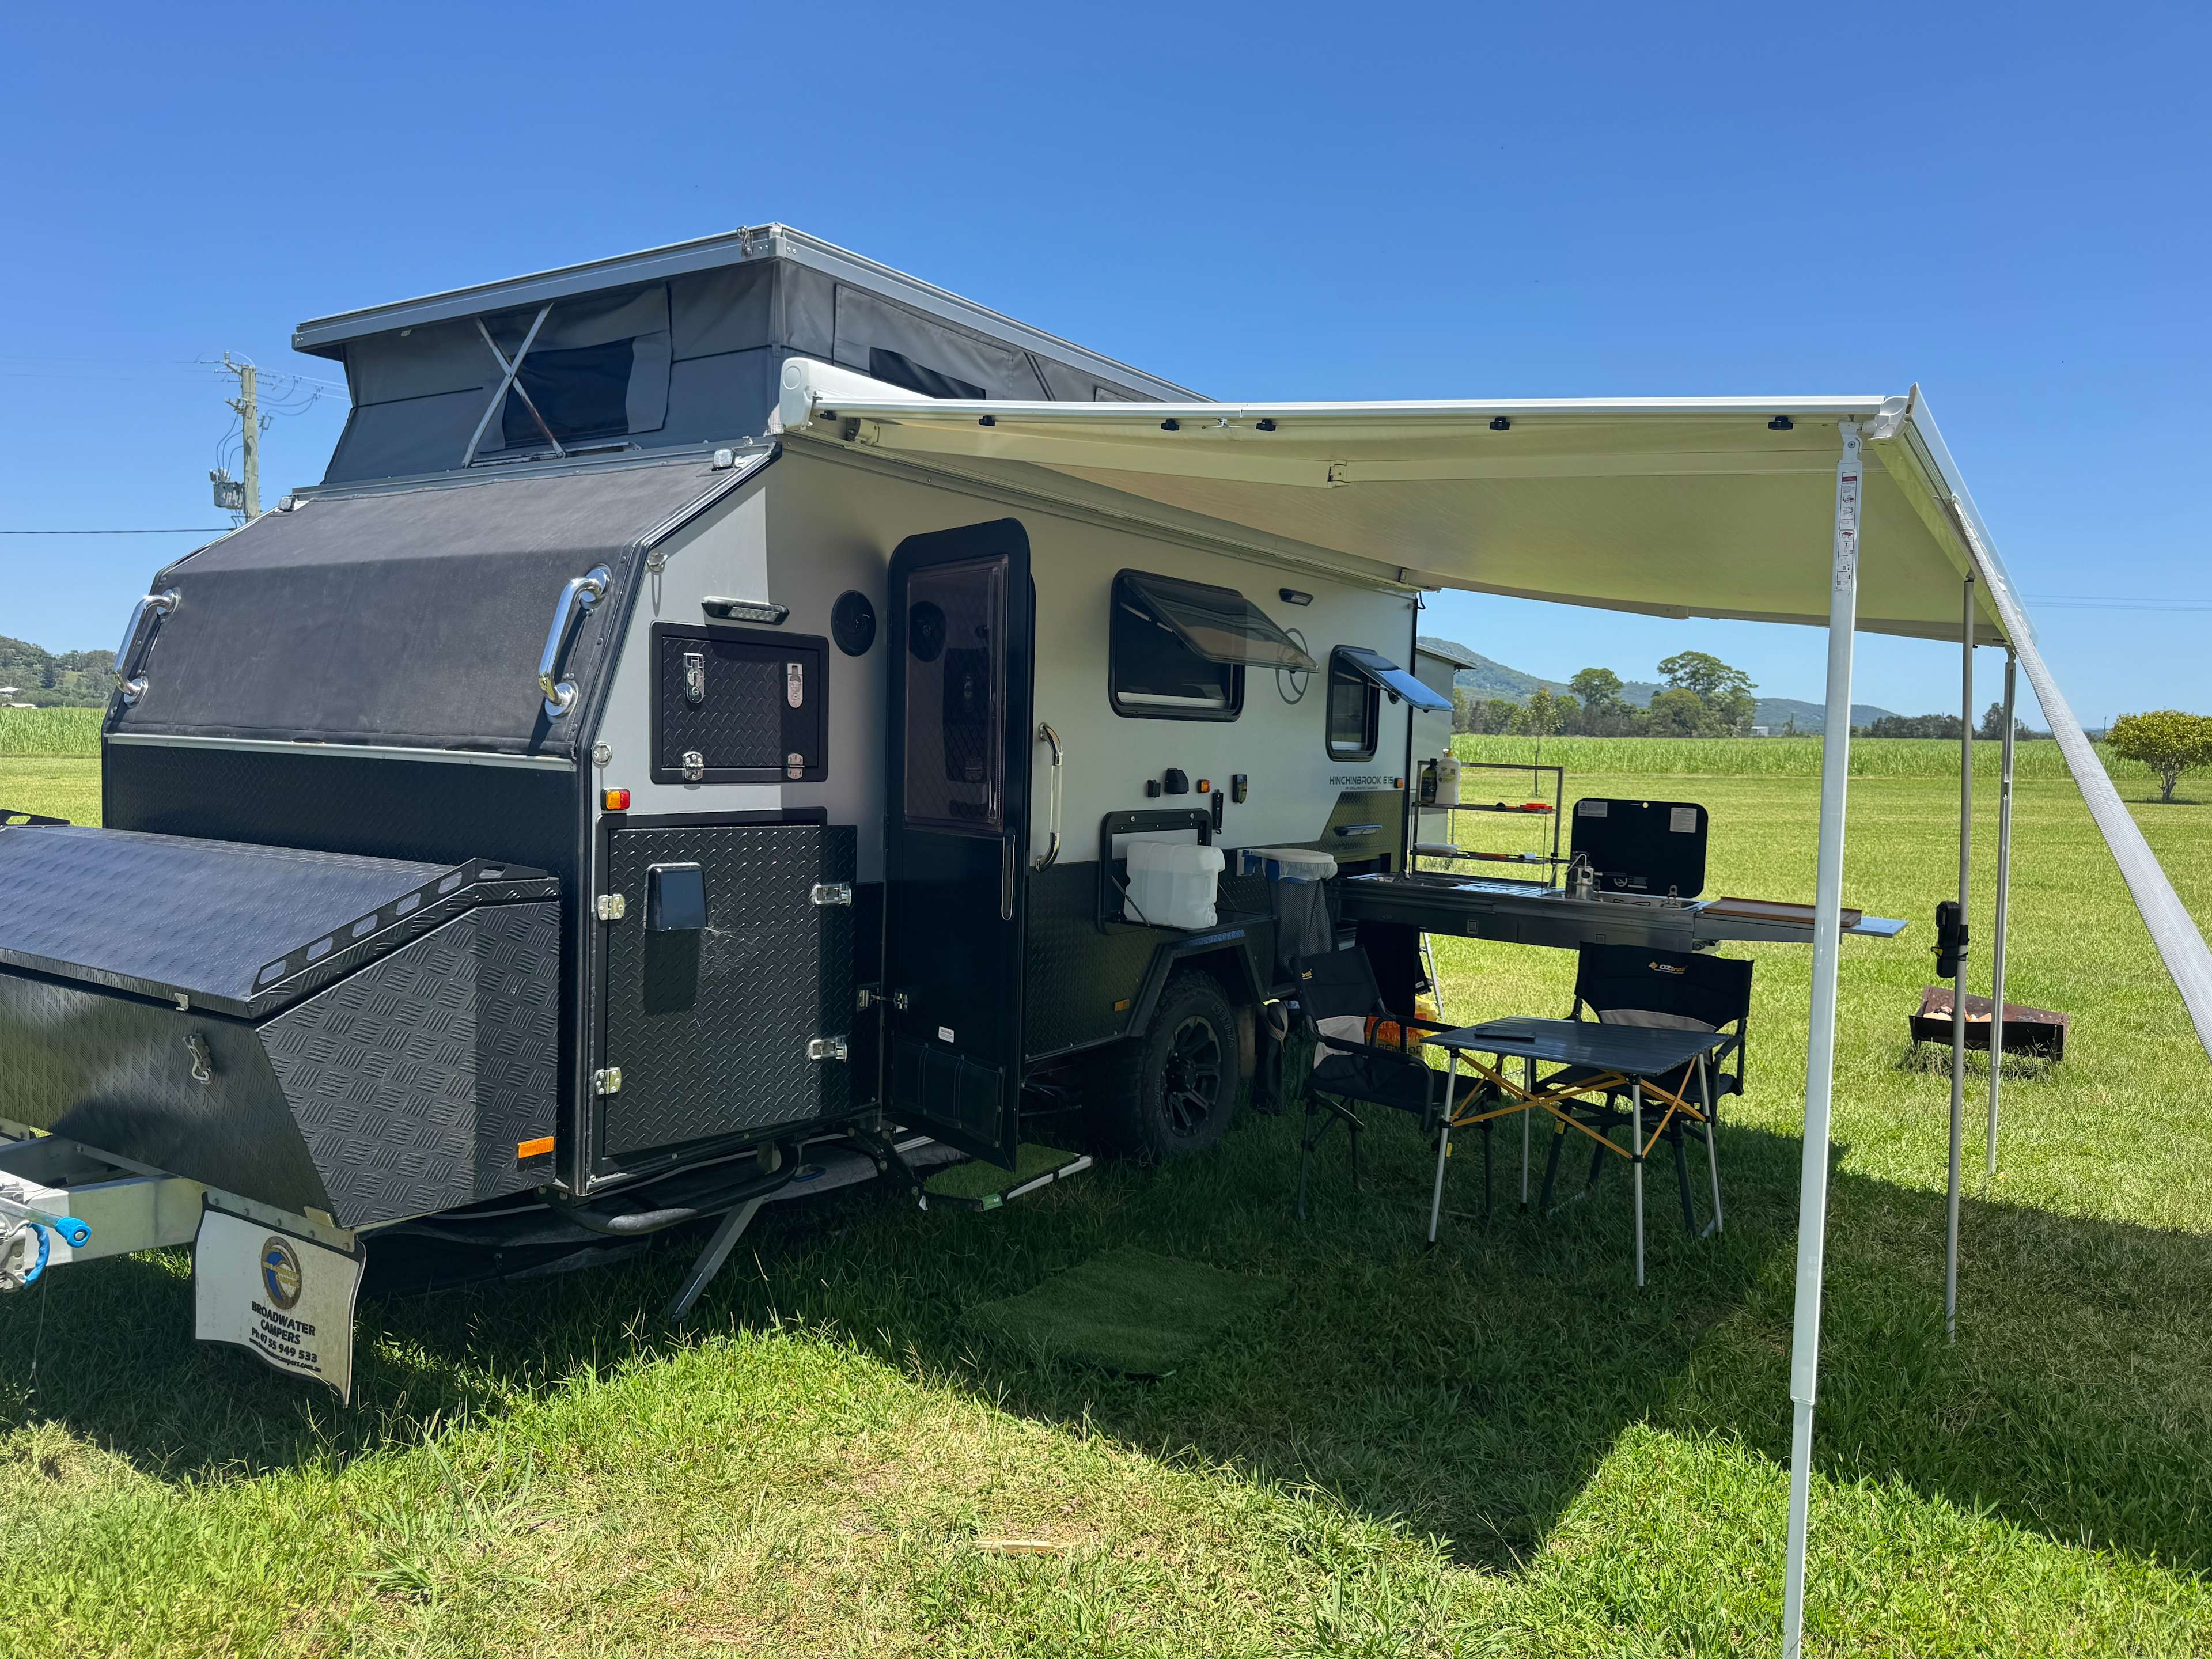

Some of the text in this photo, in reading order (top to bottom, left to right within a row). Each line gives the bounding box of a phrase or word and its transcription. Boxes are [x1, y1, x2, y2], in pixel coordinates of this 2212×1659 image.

[1329, 775, 1393, 785] HINCHINBROOK E15
[252, 1301, 316, 1336] BROADWATER
[260, 1319, 301, 1345] CAMPERS
[252, 1327, 317, 1363] Ph 07 55 949 533
